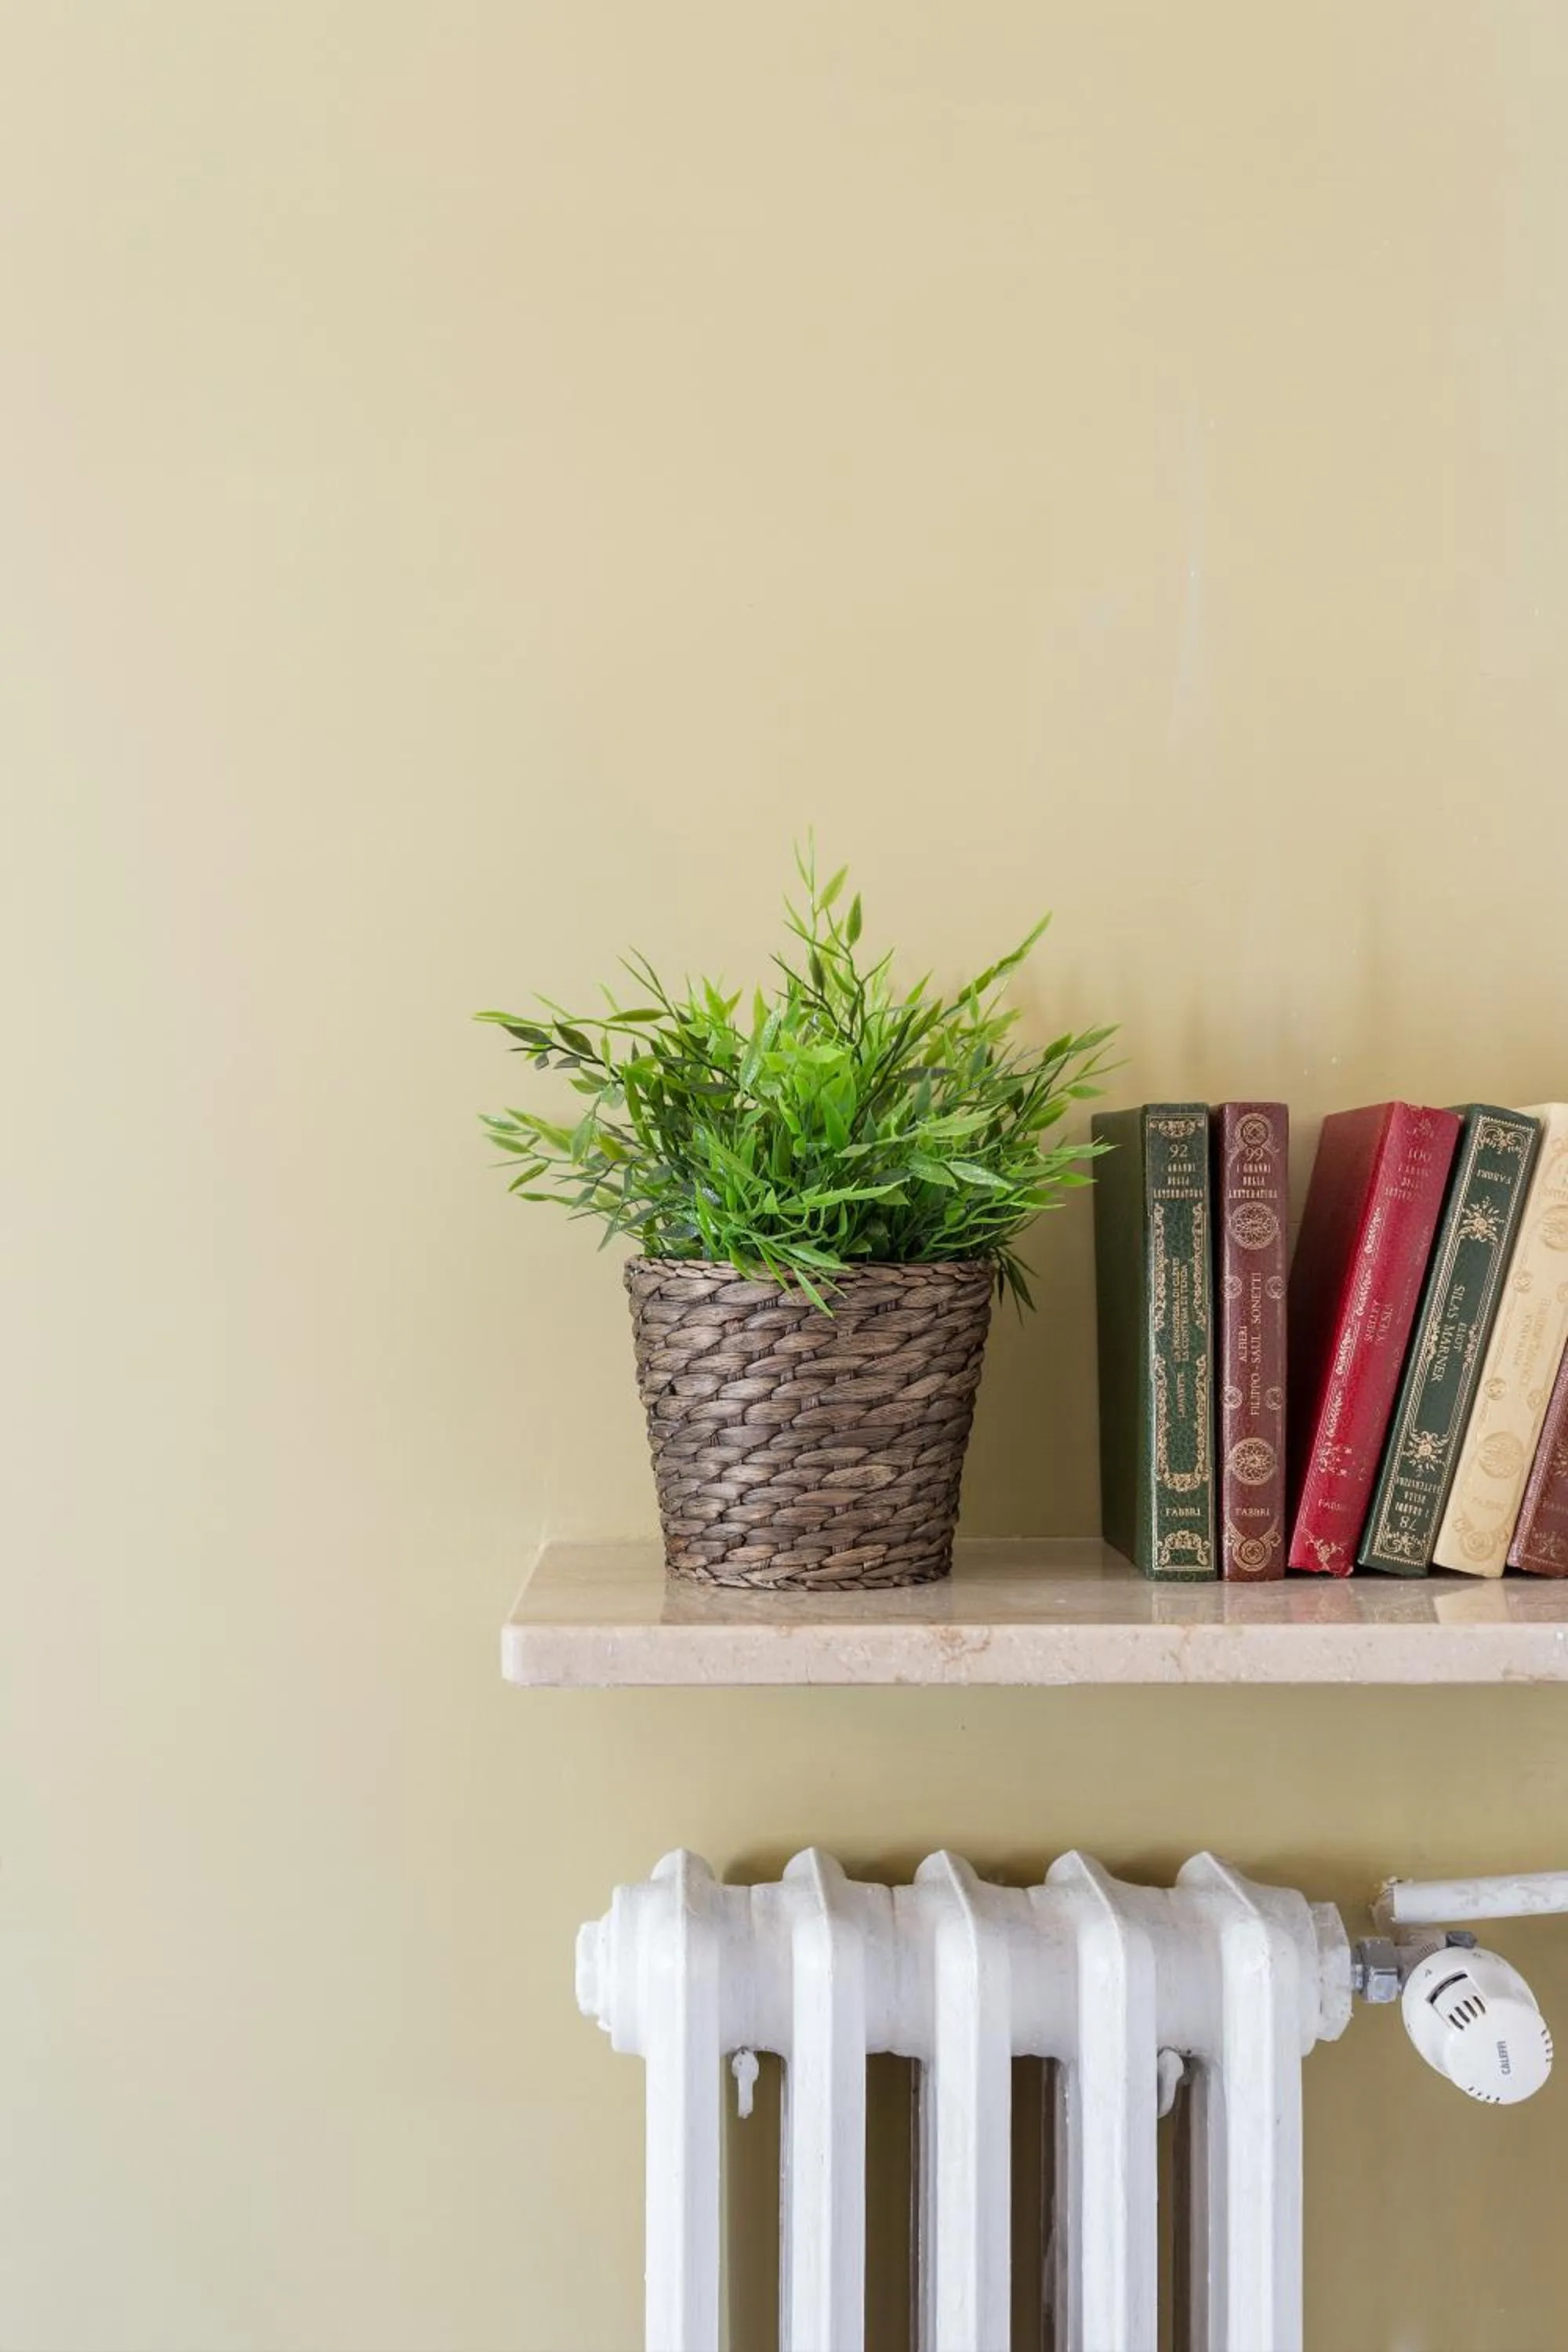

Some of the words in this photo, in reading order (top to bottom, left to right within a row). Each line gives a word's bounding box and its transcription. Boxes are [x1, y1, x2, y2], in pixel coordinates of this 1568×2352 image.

[1169, 1144, 1189, 1159] 92
[1246, 1147, 1265, 1161] 99
[1250, 1272, 1262, 1324] SONETTI
[1446, 1284, 1465, 1319] SILAS
[1239, 1325, 1248, 1363] ALFIERI
[1250, 1334, 1261, 1364] SAUL
[1431, 1323, 1456, 1382] MARNER
[1454, 1321, 1467, 1352] ELIOT
[1250, 1373, 1261, 1416] FILIPPO
[1234, 1508, 1270, 1517] FABBRI
[1399, 1515, 1417, 1531] 78
[1496, 2040, 1512, 2075] CALEFFI
